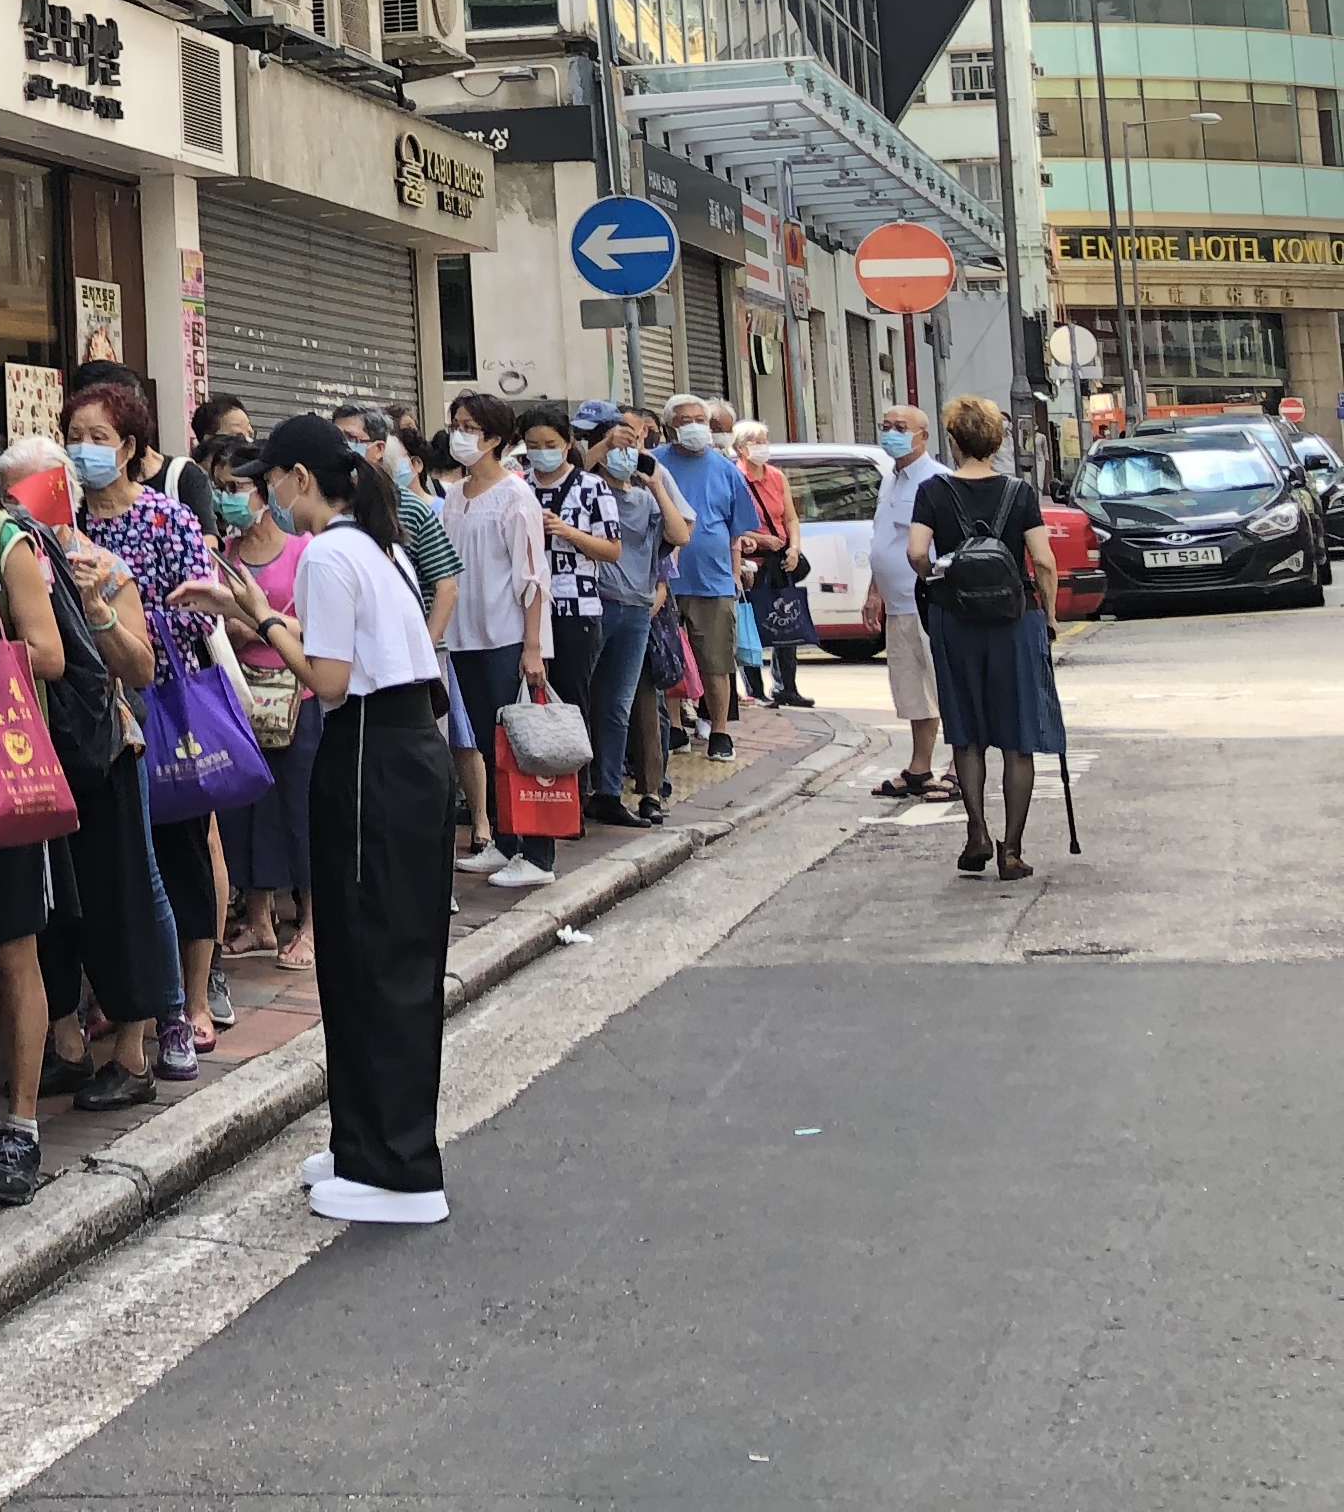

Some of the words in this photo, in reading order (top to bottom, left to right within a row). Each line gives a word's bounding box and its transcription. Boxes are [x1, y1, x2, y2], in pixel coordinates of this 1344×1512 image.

[427, 149, 451, 186] KABO
[453, 159, 485, 198] BURGER
[1081, 236, 1180, 261] EMPIRE
[1187, 235, 1267, 263] HOTEL
[1149, 552, 1171, 564] TT
[1177, 550, 1215, 563] 5341
